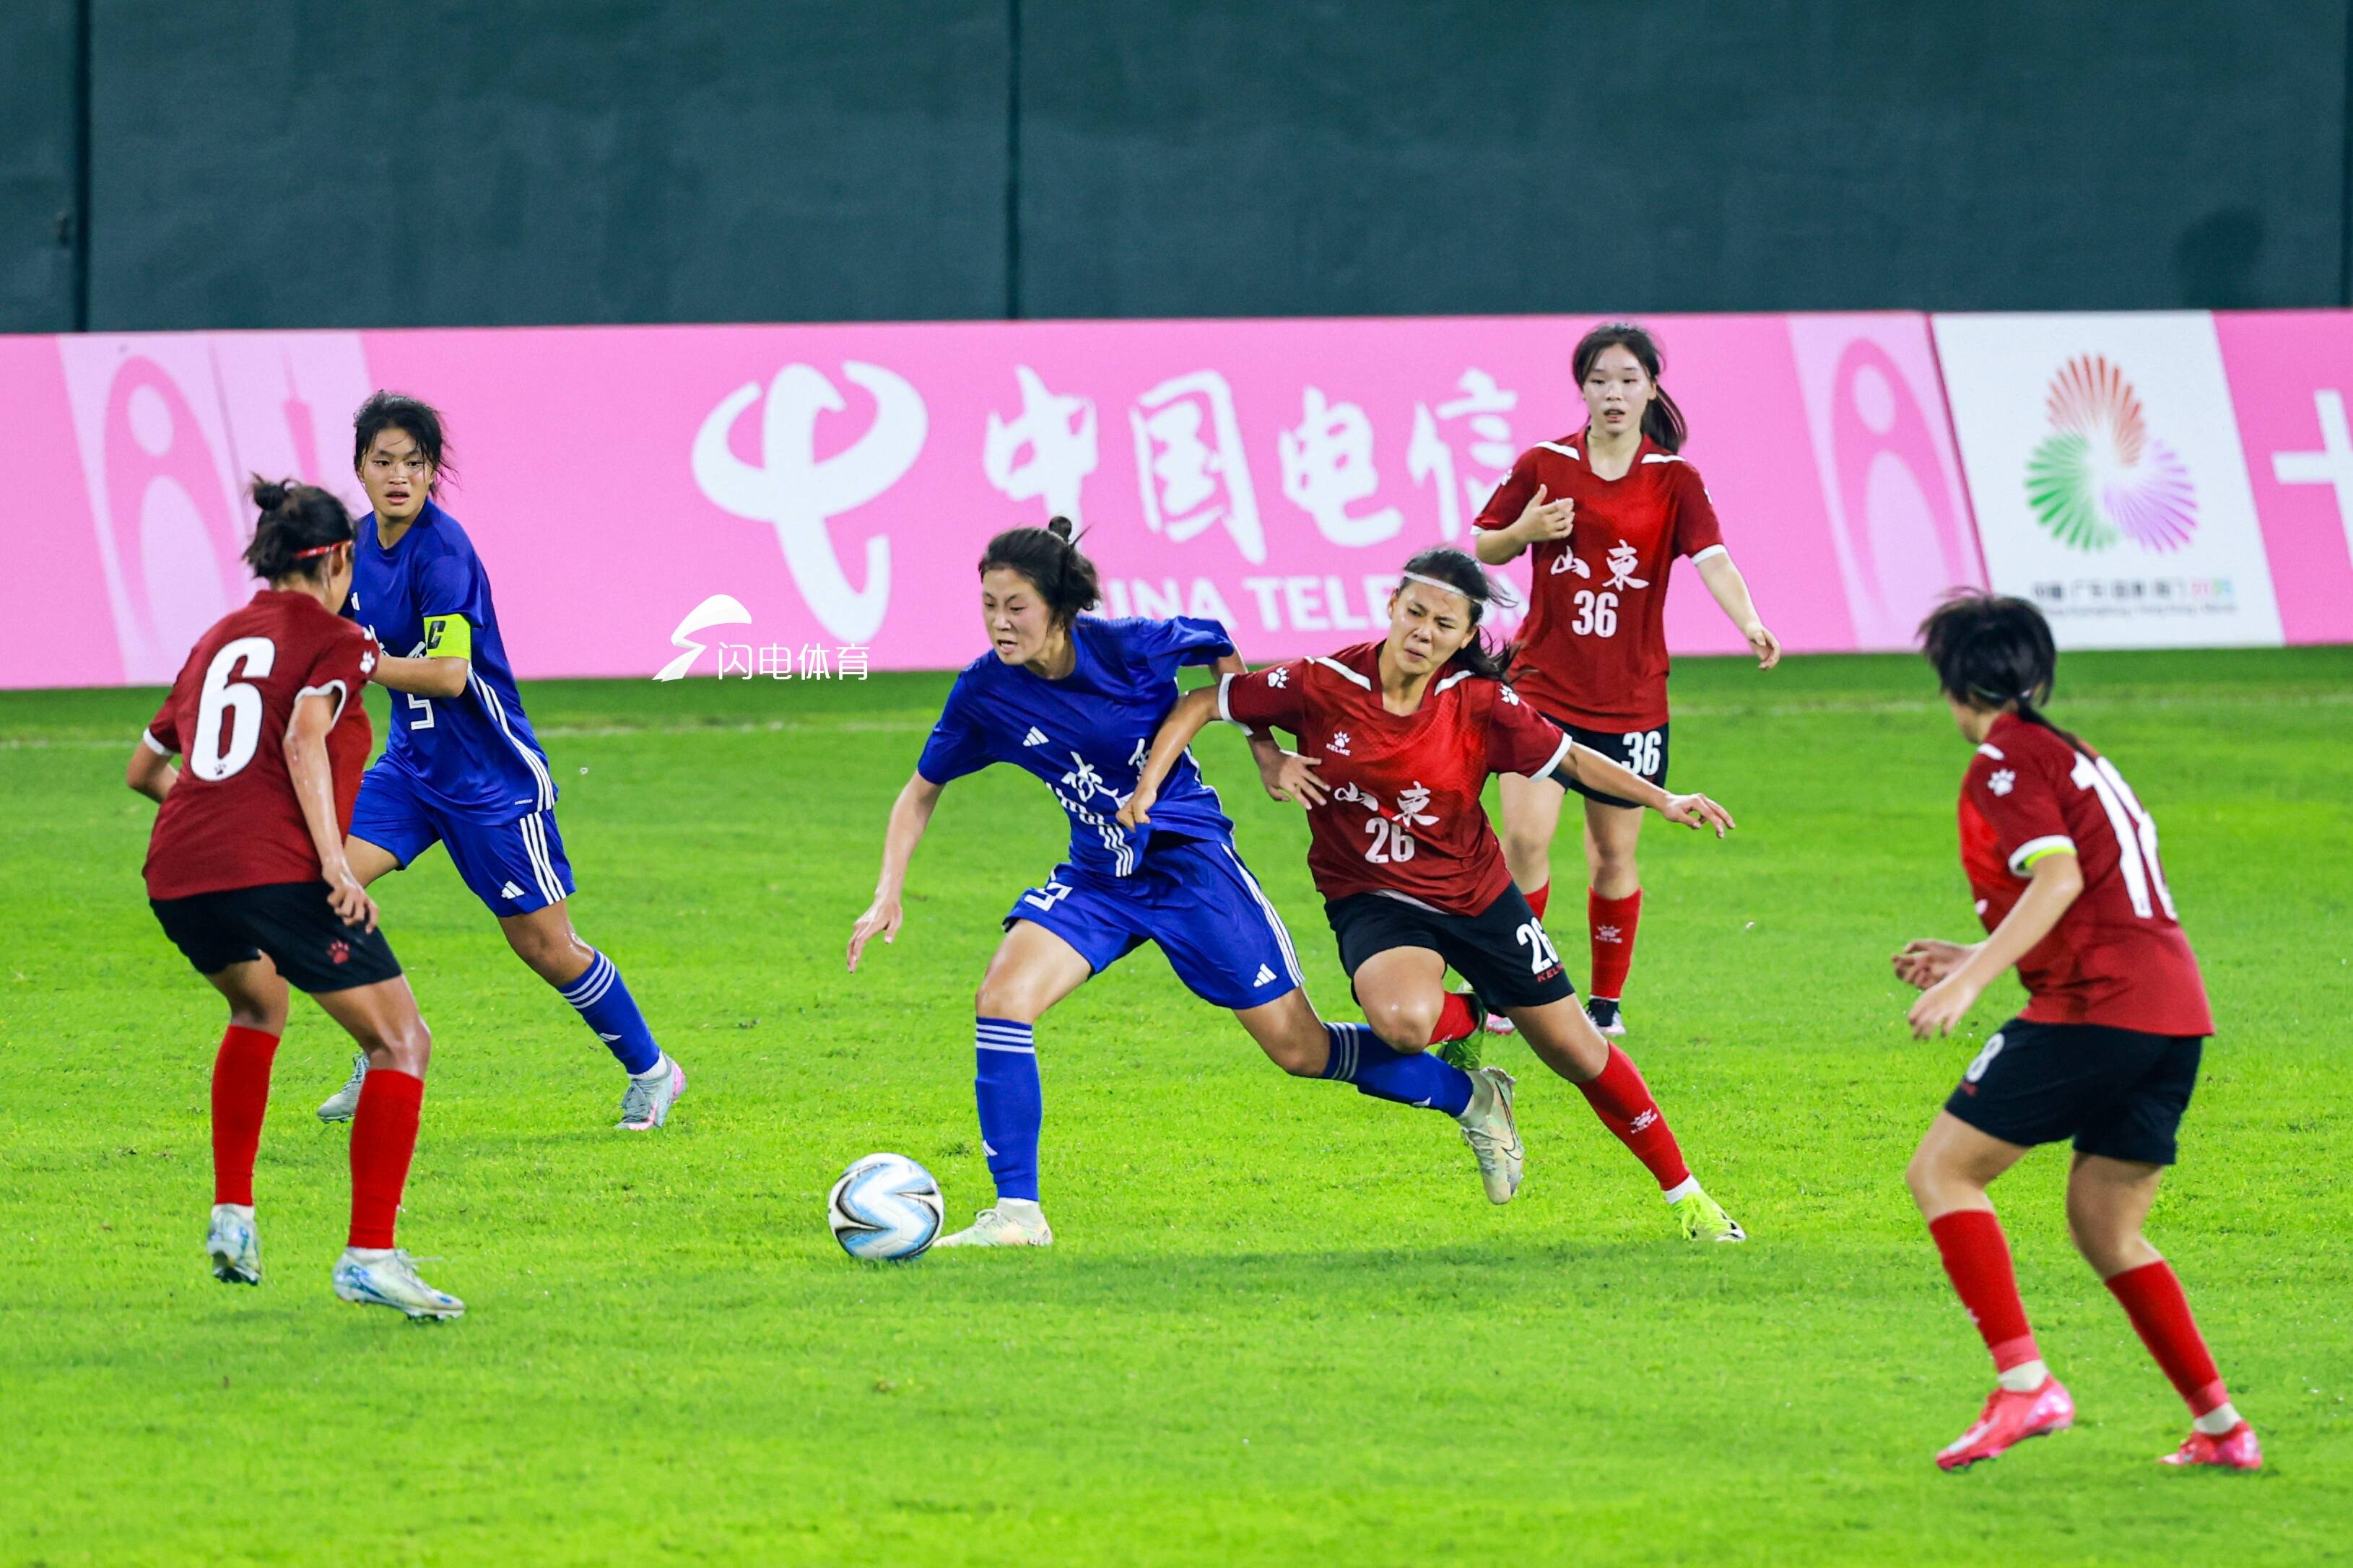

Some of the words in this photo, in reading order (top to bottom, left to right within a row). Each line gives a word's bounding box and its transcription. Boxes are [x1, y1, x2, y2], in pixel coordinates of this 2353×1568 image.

[983, 362, 1518, 565] 中国电信
[1092, 578, 1237, 633] INA
[1571, 589, 1619, 637] 36
[427, 620, 446, 650] C
[191, 637, 276, 782] 6
[406, 693, 435, 731] 5
[1620, 730, 1662, 776] 36
[1365, 816, 1415, 863] 26
[1516, 916, 1559, 975] 26
